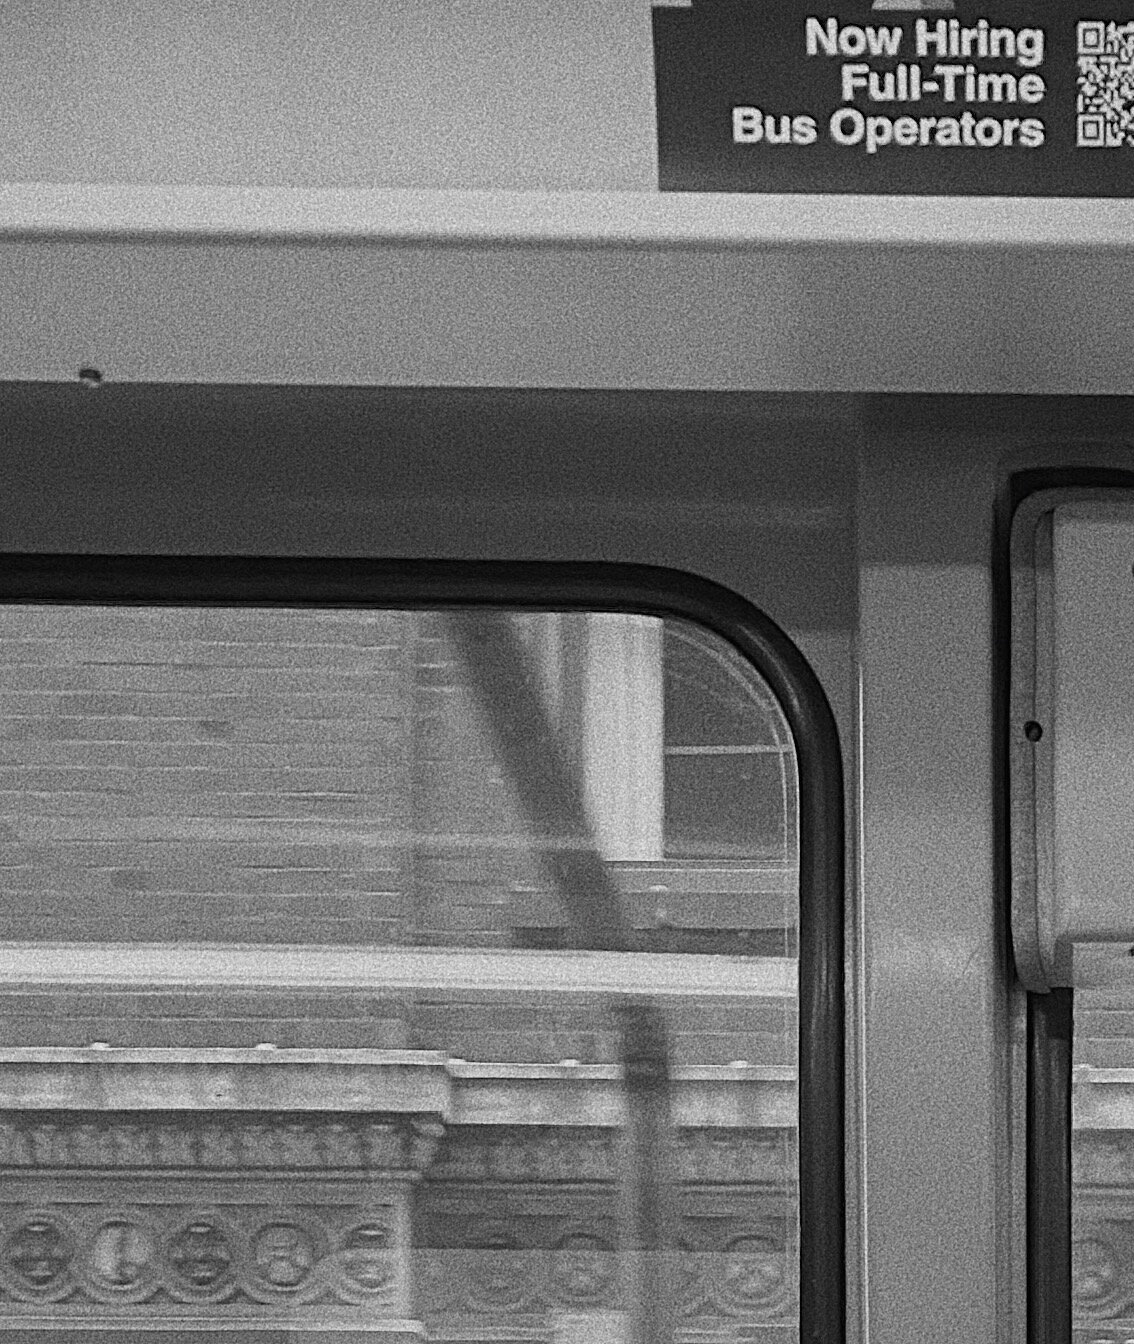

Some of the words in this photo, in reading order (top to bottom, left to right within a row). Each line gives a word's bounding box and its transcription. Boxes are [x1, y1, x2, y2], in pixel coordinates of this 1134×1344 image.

[805, 17, 902, 56] Now
[915, 18, 1044, 67] Hiring
[840, 63, 1045, 102] Full-Time
[732, 106, 817, 145] Bus
[829, 107, 1045, 153] Operators
